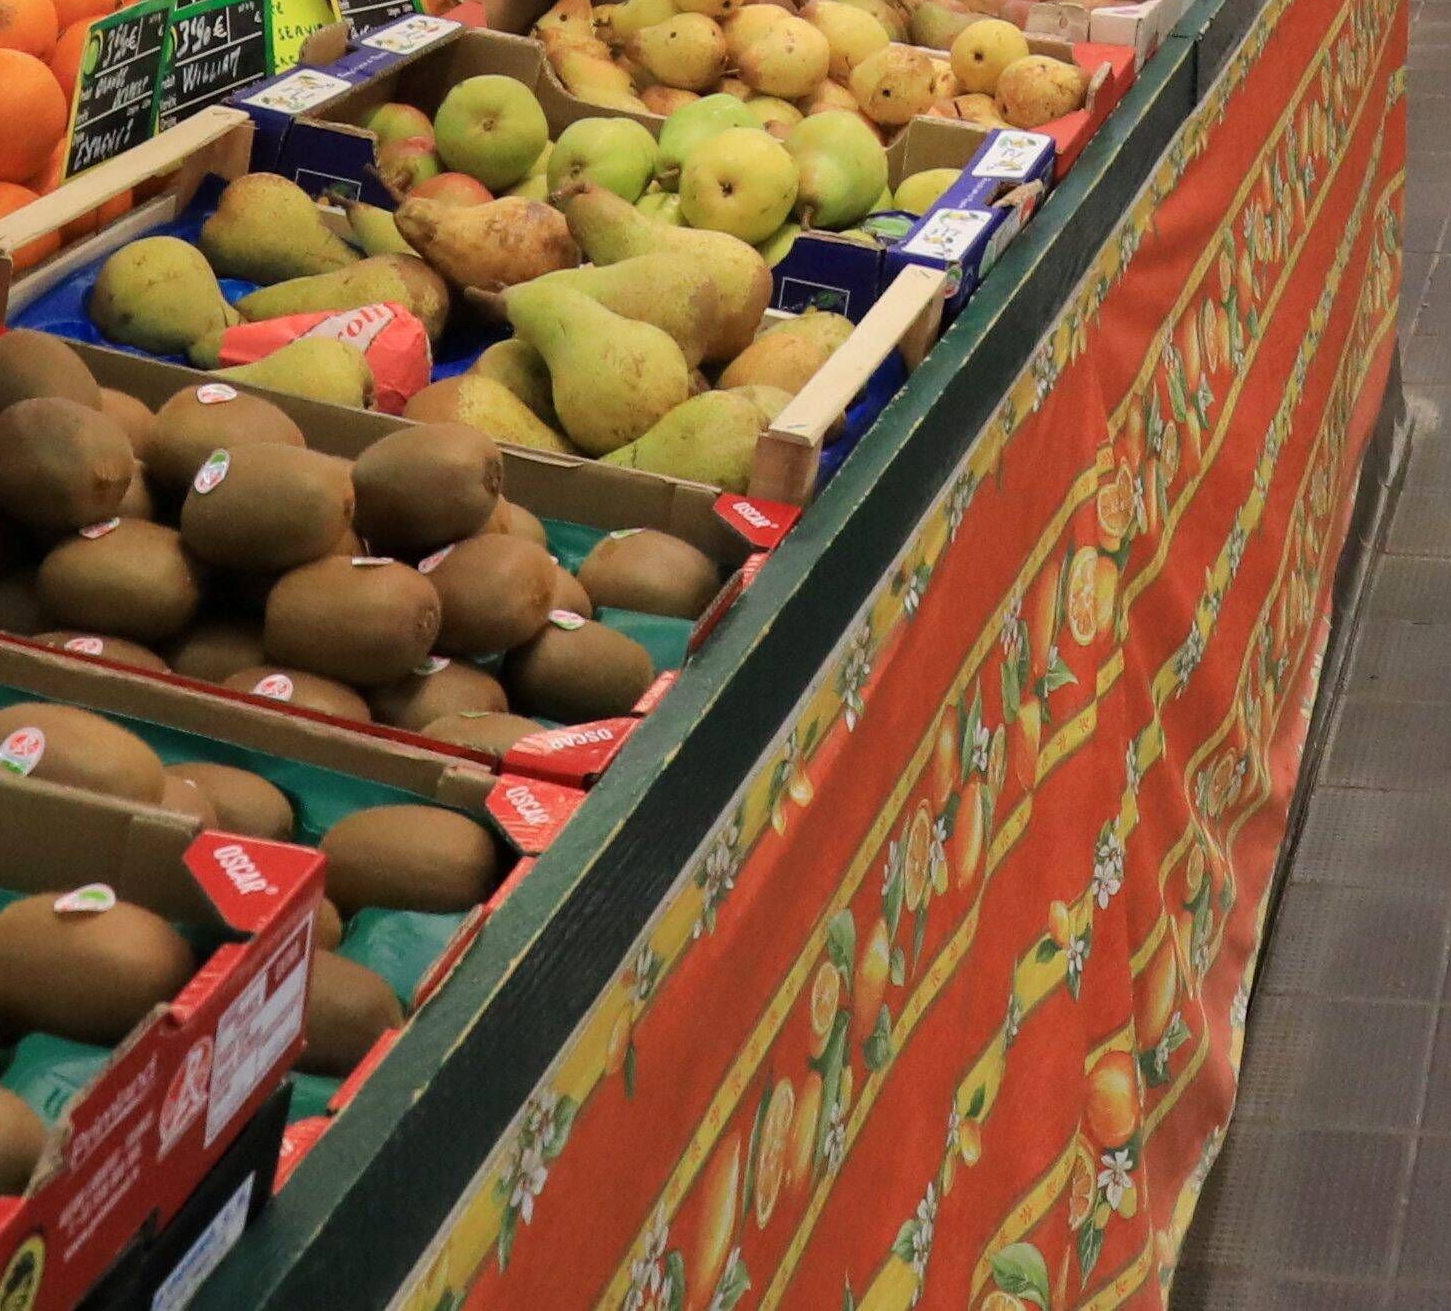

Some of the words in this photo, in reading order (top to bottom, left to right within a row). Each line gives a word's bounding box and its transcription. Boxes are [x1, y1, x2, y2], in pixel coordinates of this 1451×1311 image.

[732, 501, 771, 529] OSCAR
[505, 785, 550, 826] OSCAR
[211, 843, 267, 895] OSCAR
